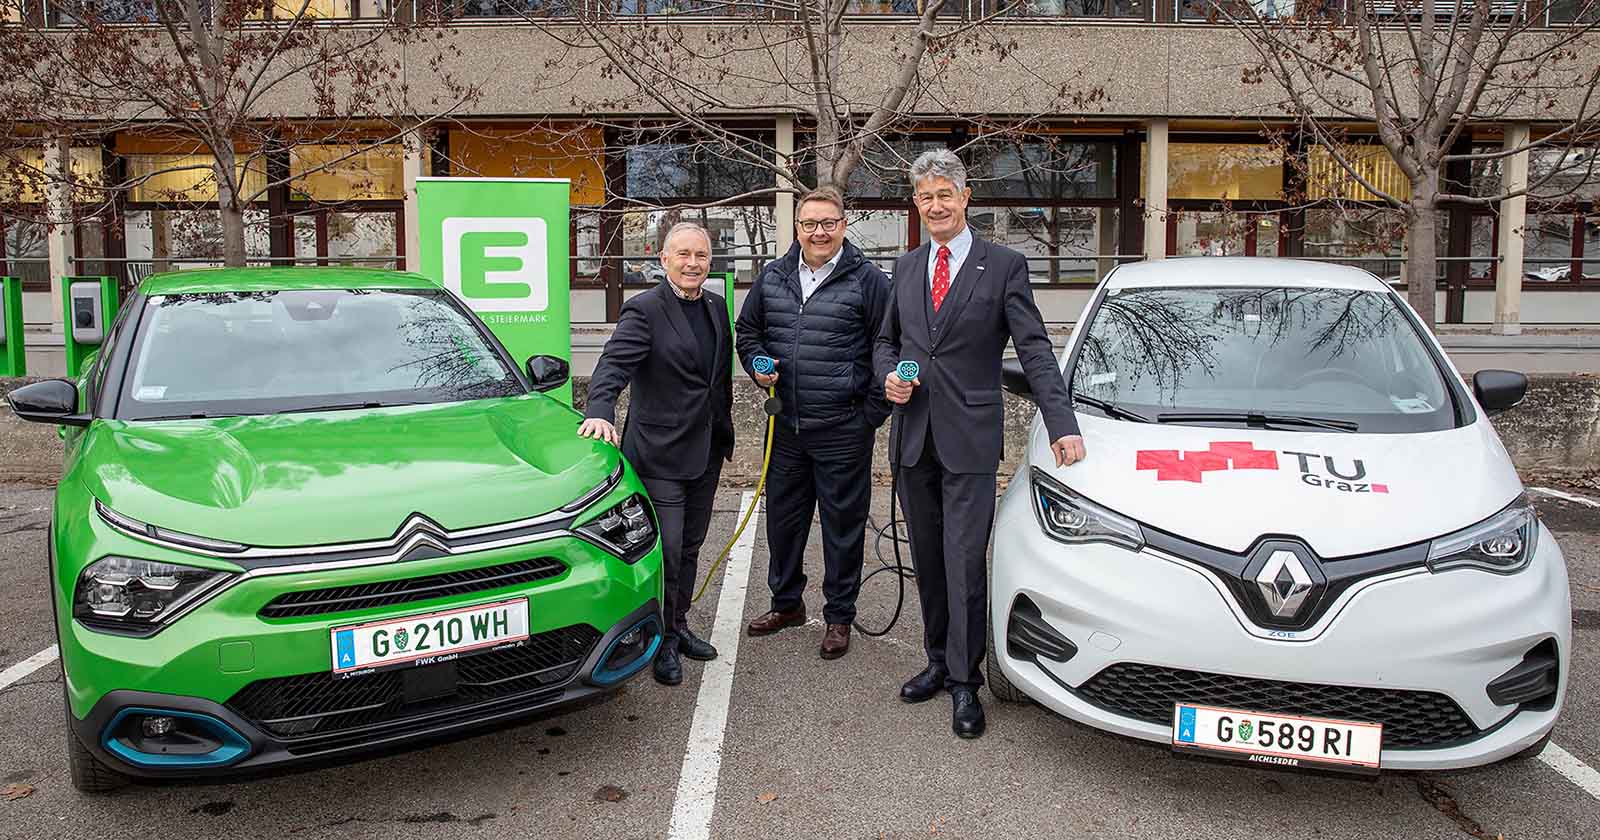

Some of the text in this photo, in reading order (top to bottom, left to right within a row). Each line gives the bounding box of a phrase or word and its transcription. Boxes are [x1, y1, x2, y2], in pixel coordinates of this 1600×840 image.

[460, 231, 532, 299] E
[489, 314, 549, 324] STEIERMARK
[1282, 450, 1366, 481] TU
[1301, 474, 1370, 493] Graz
[372, 609, 508, 657] G 210 WH
[342, 653, 351, 663] A
[415, 653, 459, 667] FWK GmbH
[1182, 728, 1191, 737] A
[1217, 716, 1353, 756] G 589 RI
[1248, 754, 1299, 767] AICHLSEDER
